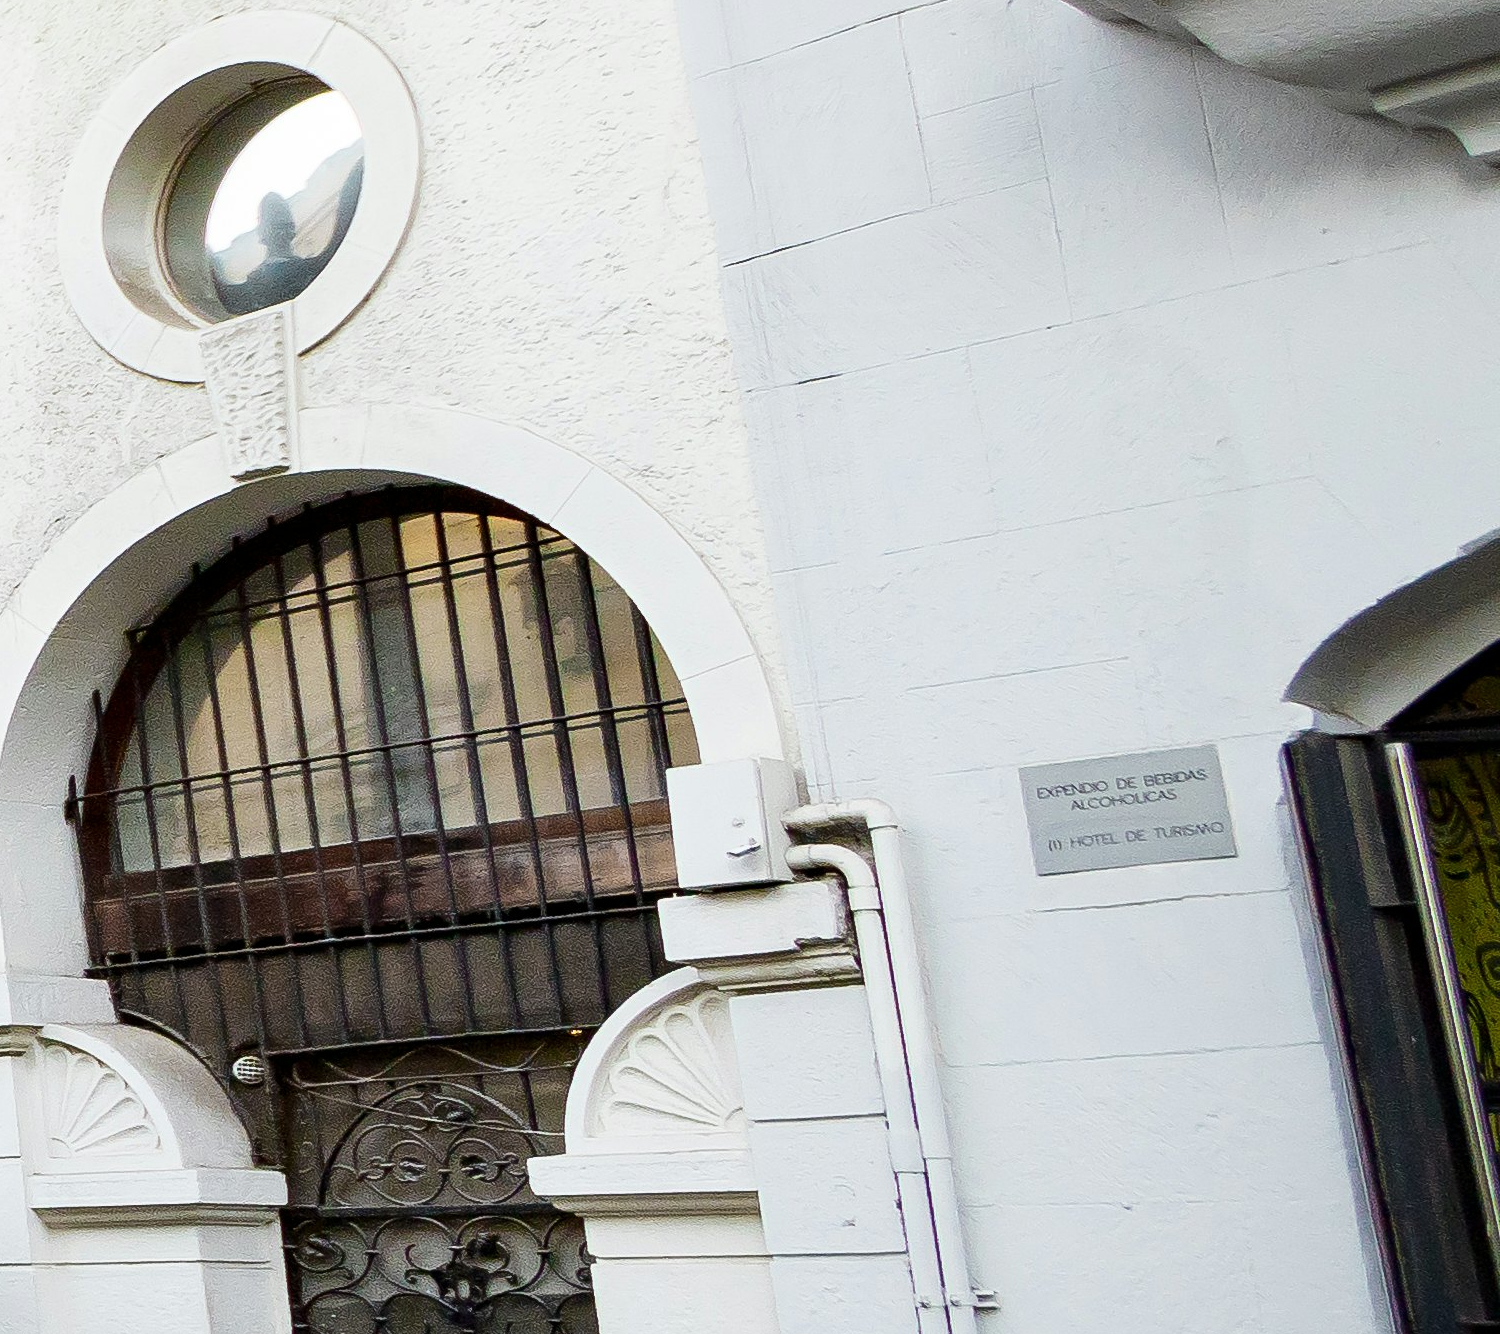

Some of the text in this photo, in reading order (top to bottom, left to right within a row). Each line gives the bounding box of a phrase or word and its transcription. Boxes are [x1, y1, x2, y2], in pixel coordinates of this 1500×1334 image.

[1037, 769, 1208, 799] EXPENDIO DE BEBIDAS
[1070, 833, 1121, 848] HOTEL
[1125, 829, 1148, 843] DE
[1154, 822, 1224, 839] TURISMO
